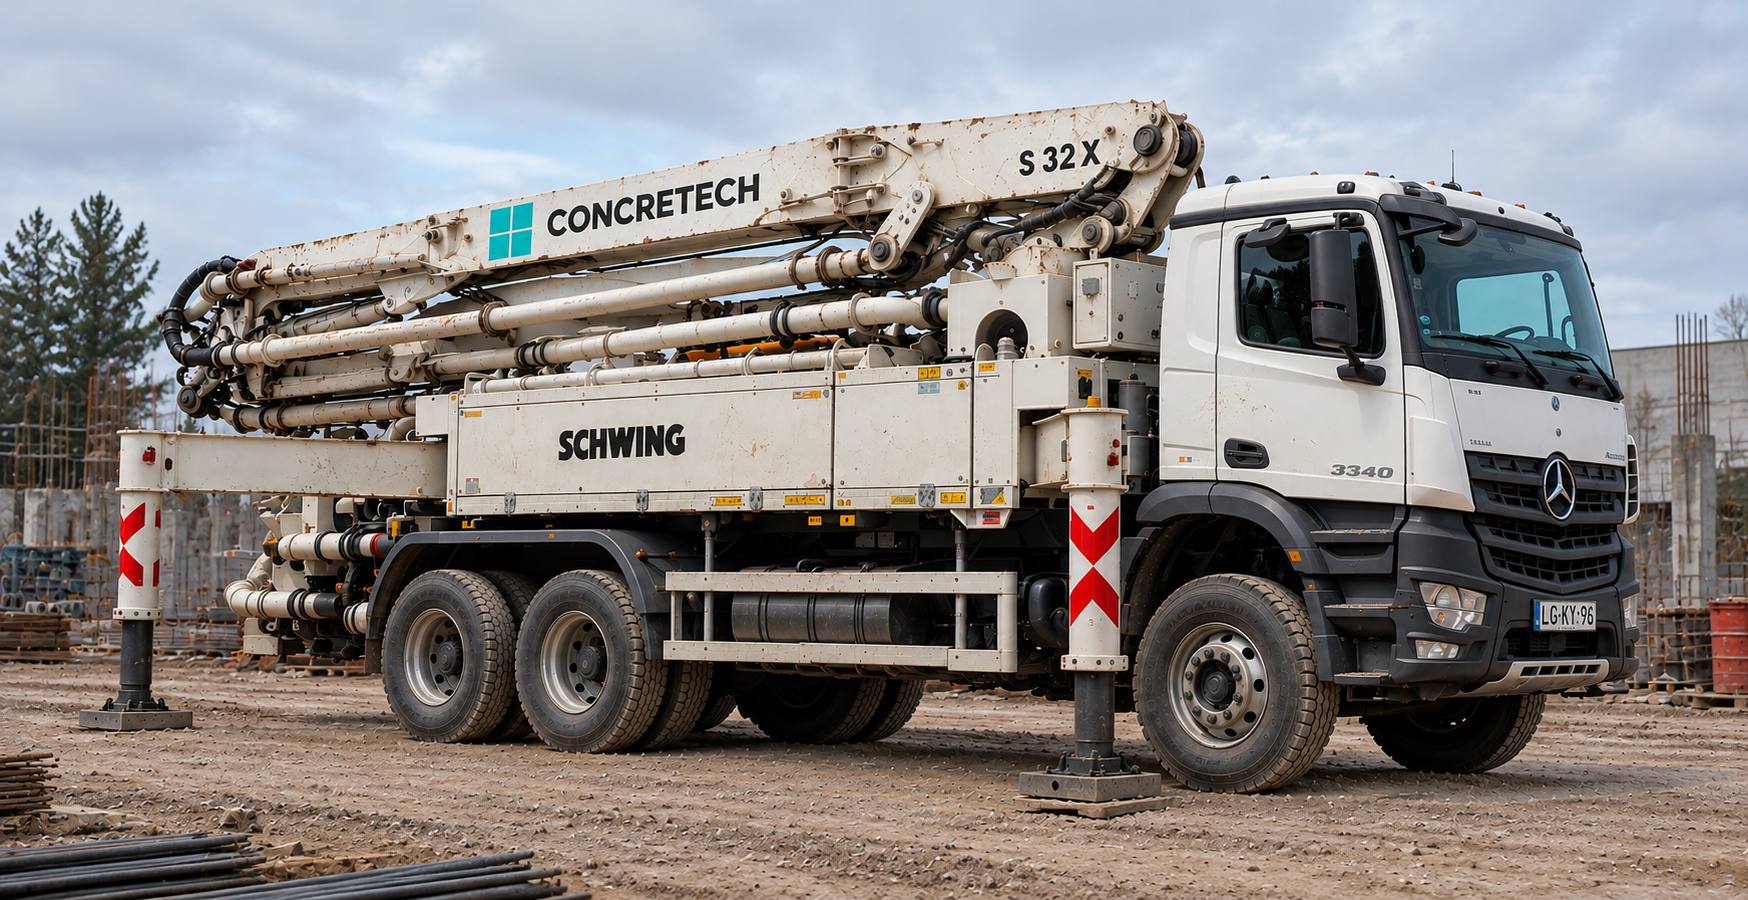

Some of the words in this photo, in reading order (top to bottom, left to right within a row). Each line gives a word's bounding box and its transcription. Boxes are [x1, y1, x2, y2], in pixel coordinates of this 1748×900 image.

[1019, 150, 1035, 176] S
[1042, 143, 1076, 172] 32
[1081, 138, 1101, 167] X
[547, 173, 760, 237] CONCRETECH
[558, 423, 686, 461] SCHWING
[1330, 464, 1394, 479] 3340
